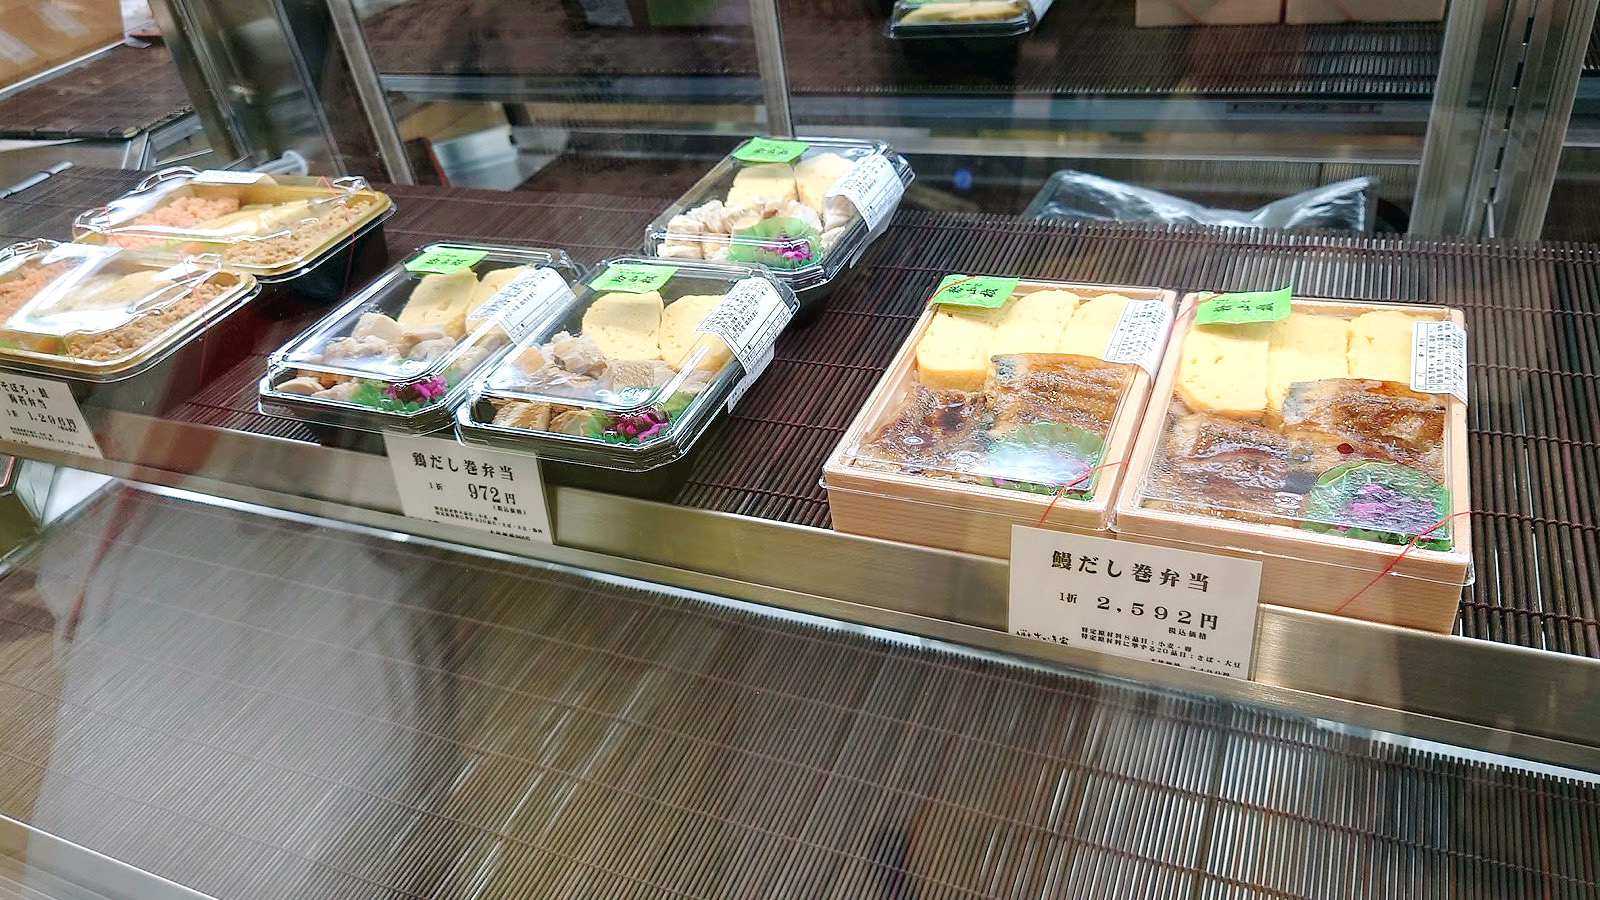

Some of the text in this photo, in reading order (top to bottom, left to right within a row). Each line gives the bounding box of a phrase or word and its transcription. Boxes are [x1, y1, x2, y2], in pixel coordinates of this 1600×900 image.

[412, 452, 514, 481] 鶏だし巻弁当
[468, 483, 516, 505] 972円
[1051, 550, 1209, 592] 鰻だし巻弁当
[1059, 592, 1218, 630] 1折 2,592円
[1168, 627, 1207, 640] 税込価格
